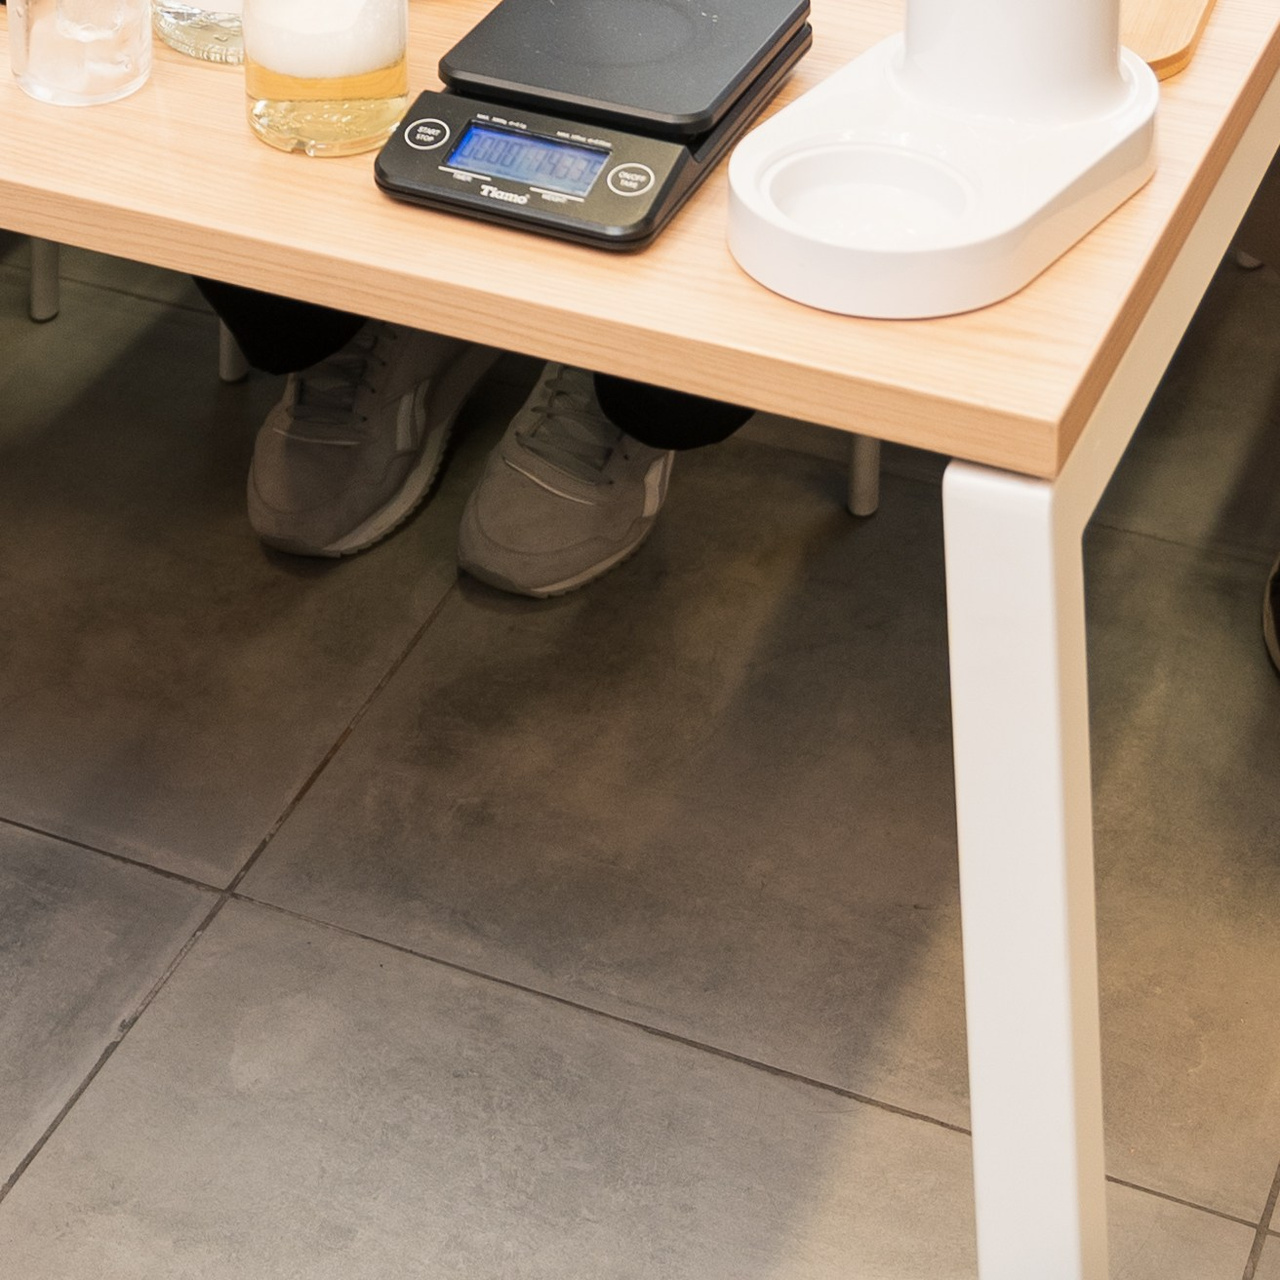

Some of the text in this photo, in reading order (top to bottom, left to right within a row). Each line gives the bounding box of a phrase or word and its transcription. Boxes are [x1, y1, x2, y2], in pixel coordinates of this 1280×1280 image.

[417, 125, 441, 137] START
[415, 133, 435, 142] STOP
[481, 184, 528, 205] Tiamo
